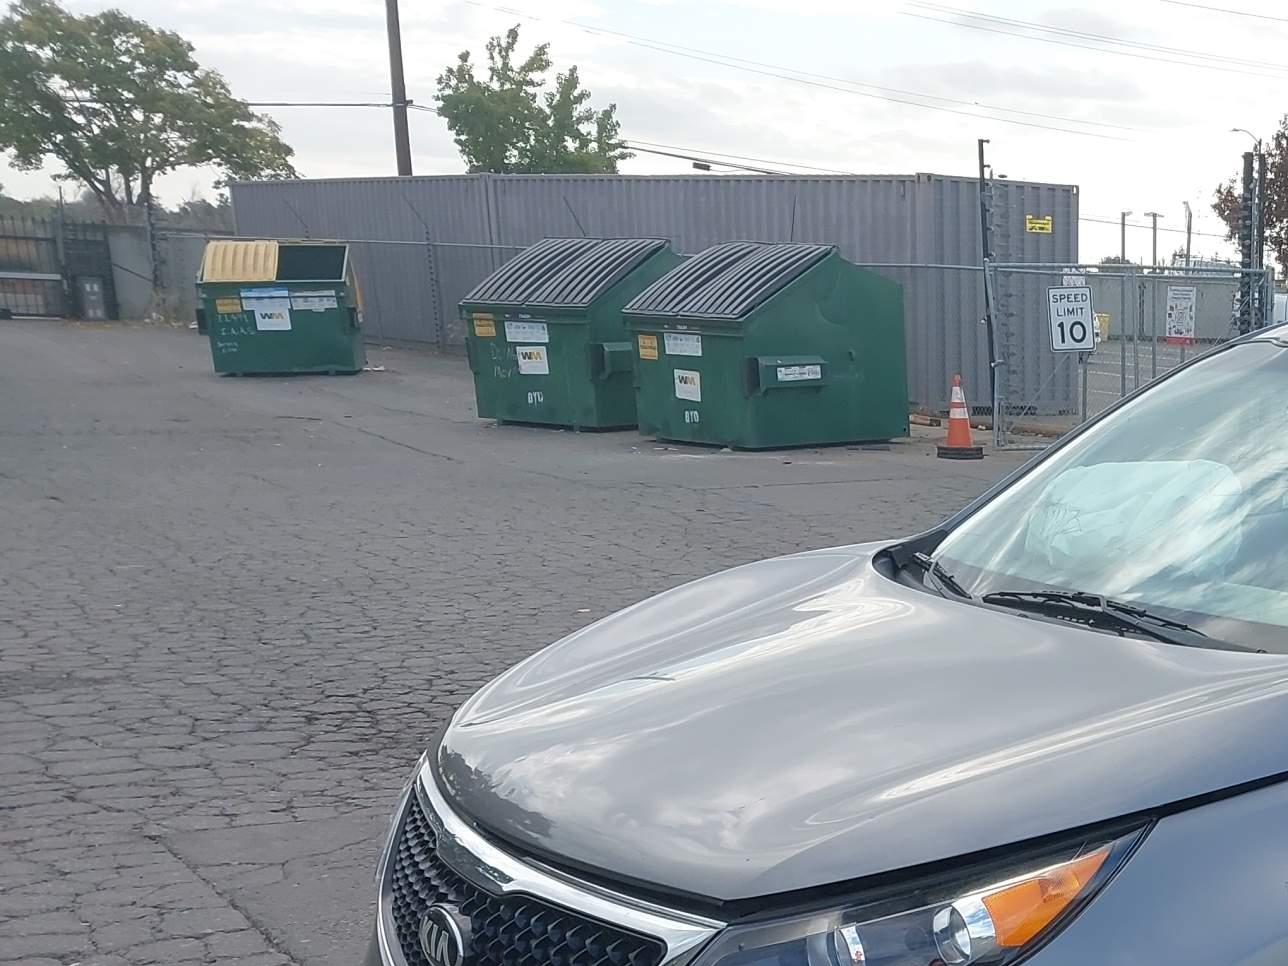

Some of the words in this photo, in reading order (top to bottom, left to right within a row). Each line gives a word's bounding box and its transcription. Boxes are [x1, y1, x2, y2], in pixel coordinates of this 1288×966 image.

[1051, 293, 1088, 304] SPEED
[1056, 307, 1085, 317] LIMIT
[1057, 321, 1087, 344] 10
[521, 351, 543, 360] WM
[678, 375, 696, 385] WM
